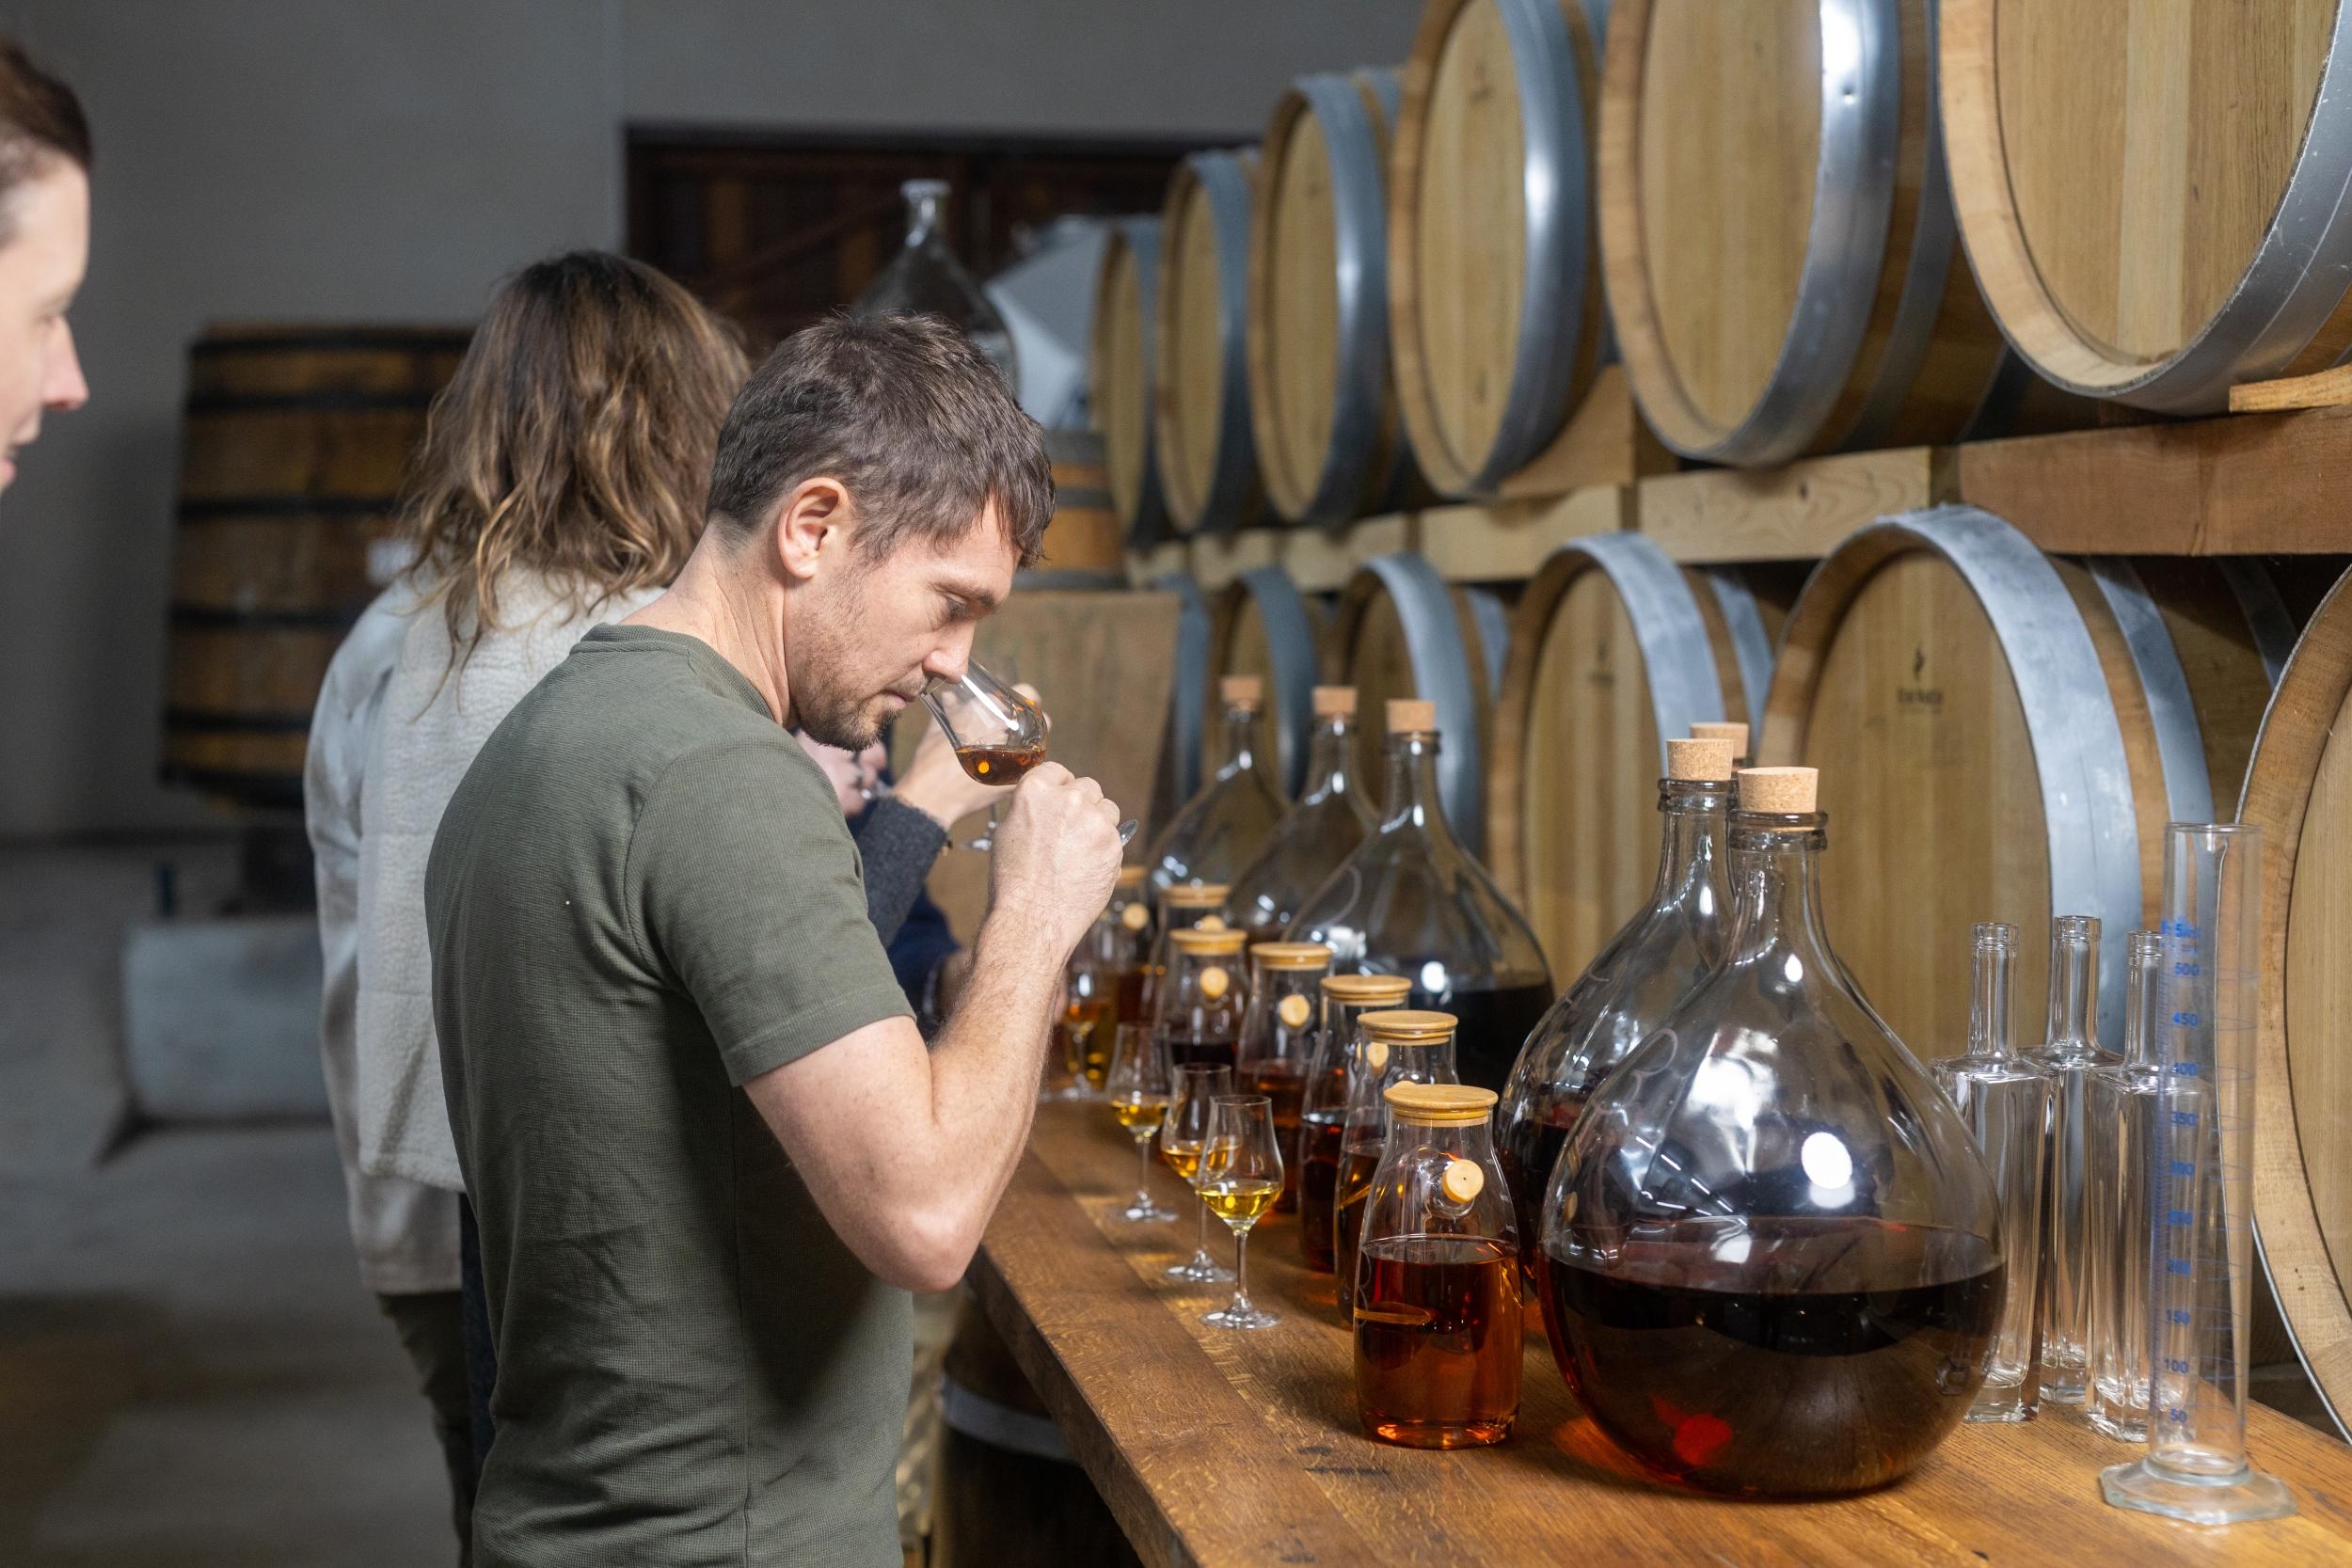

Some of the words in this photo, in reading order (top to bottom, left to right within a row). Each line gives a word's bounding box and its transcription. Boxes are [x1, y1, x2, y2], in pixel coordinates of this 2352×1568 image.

[2174, 962, 2199, 976] 500
[2172, 1011, 2199, 1028] 450
[2169, 1112, 2197, 1128] 350
[2166, 1309, 2191, 1324] 150
[2165, 1358, 2188, 1373] 100
[2169, 1408, 2187, 1423] 50
